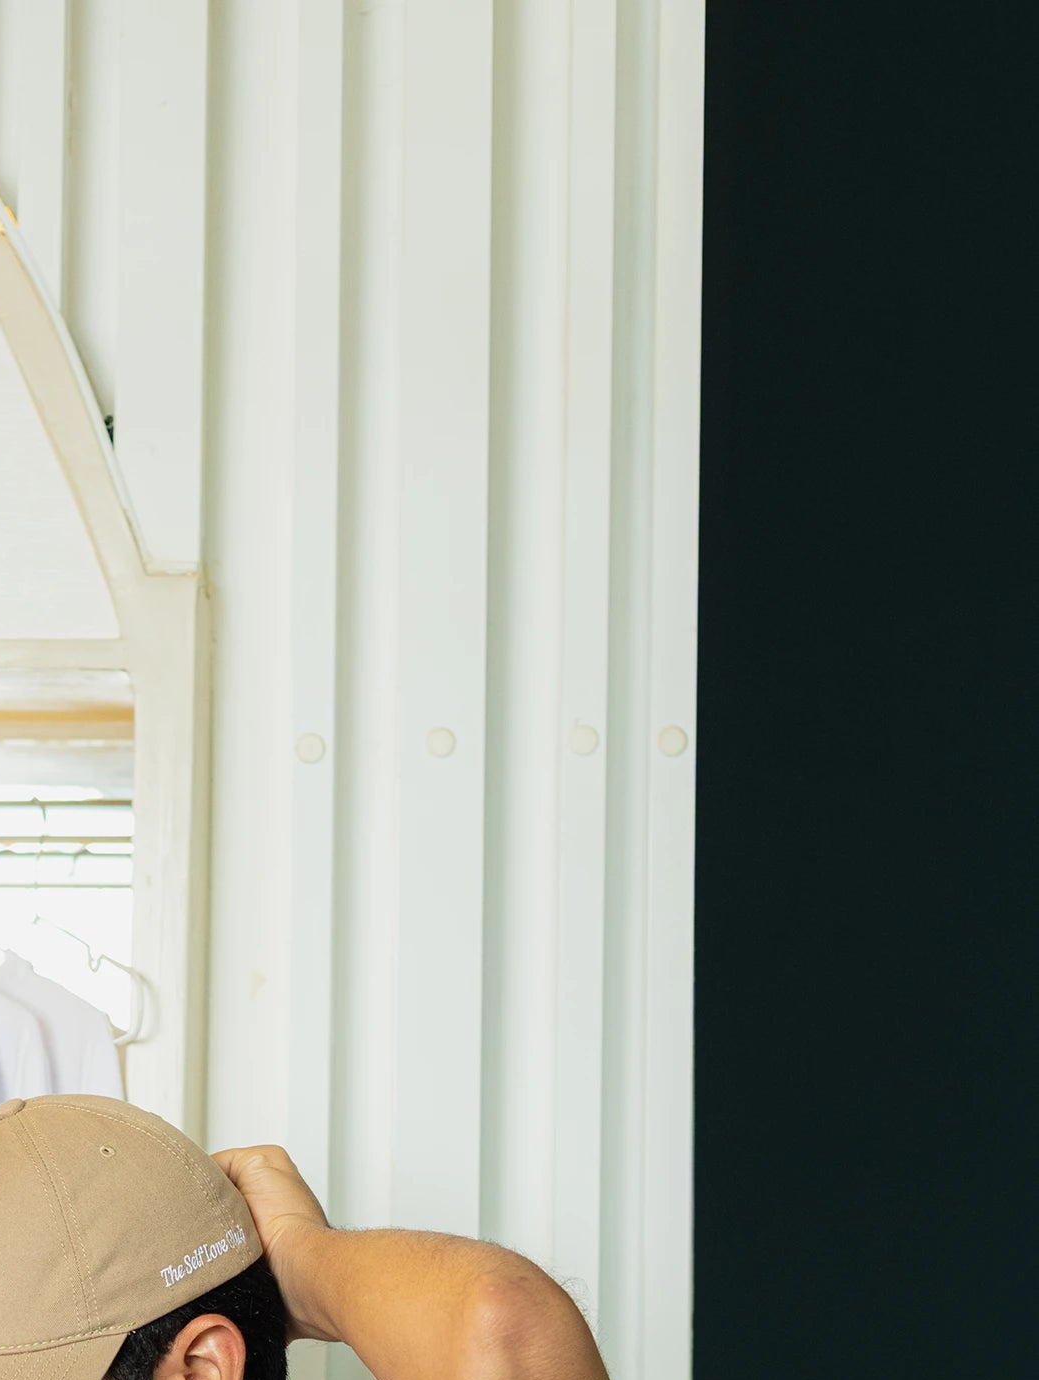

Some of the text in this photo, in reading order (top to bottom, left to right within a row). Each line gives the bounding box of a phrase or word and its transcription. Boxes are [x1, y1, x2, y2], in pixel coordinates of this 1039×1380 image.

[160, 1264, 185, 1288] The
[183, 1245, 205, 1274] Self
[202, 1238, 229, 1263] Love
